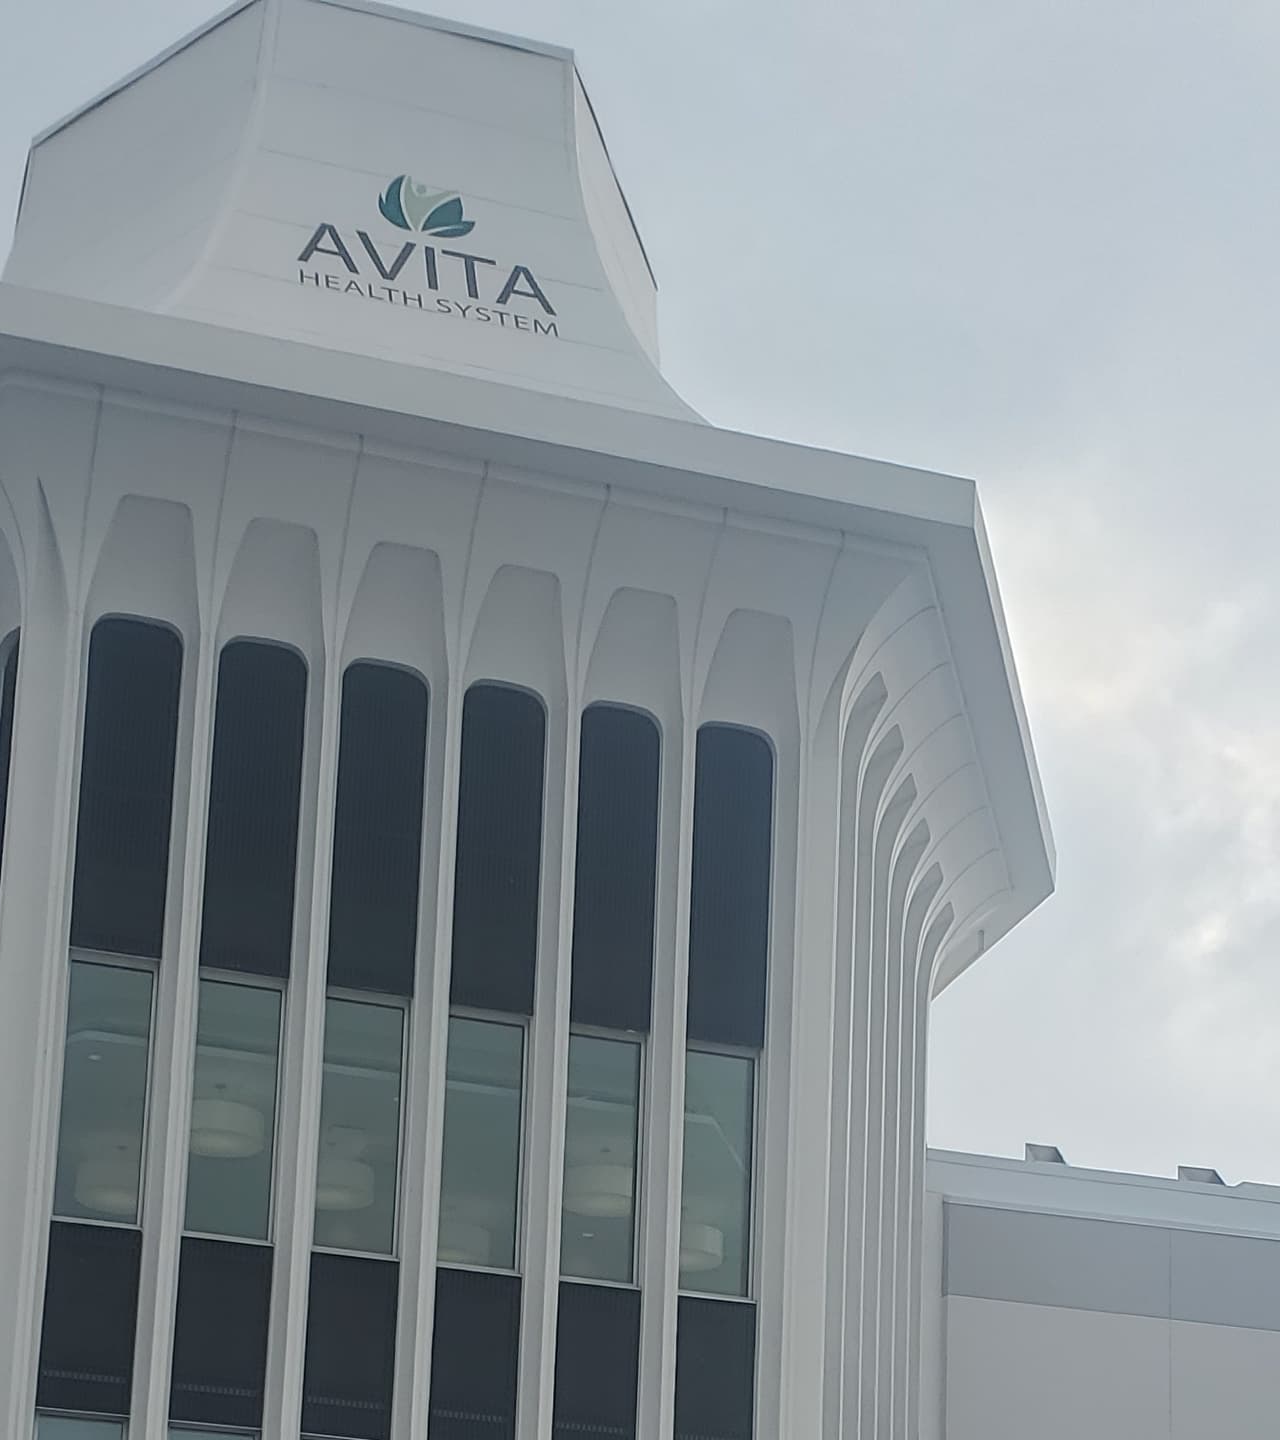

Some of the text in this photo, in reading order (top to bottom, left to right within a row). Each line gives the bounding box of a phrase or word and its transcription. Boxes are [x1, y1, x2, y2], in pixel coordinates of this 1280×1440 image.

[297, 222, 557, 316] AVITA
[298, 268, 560, 338] HEALTH SYSTEM
